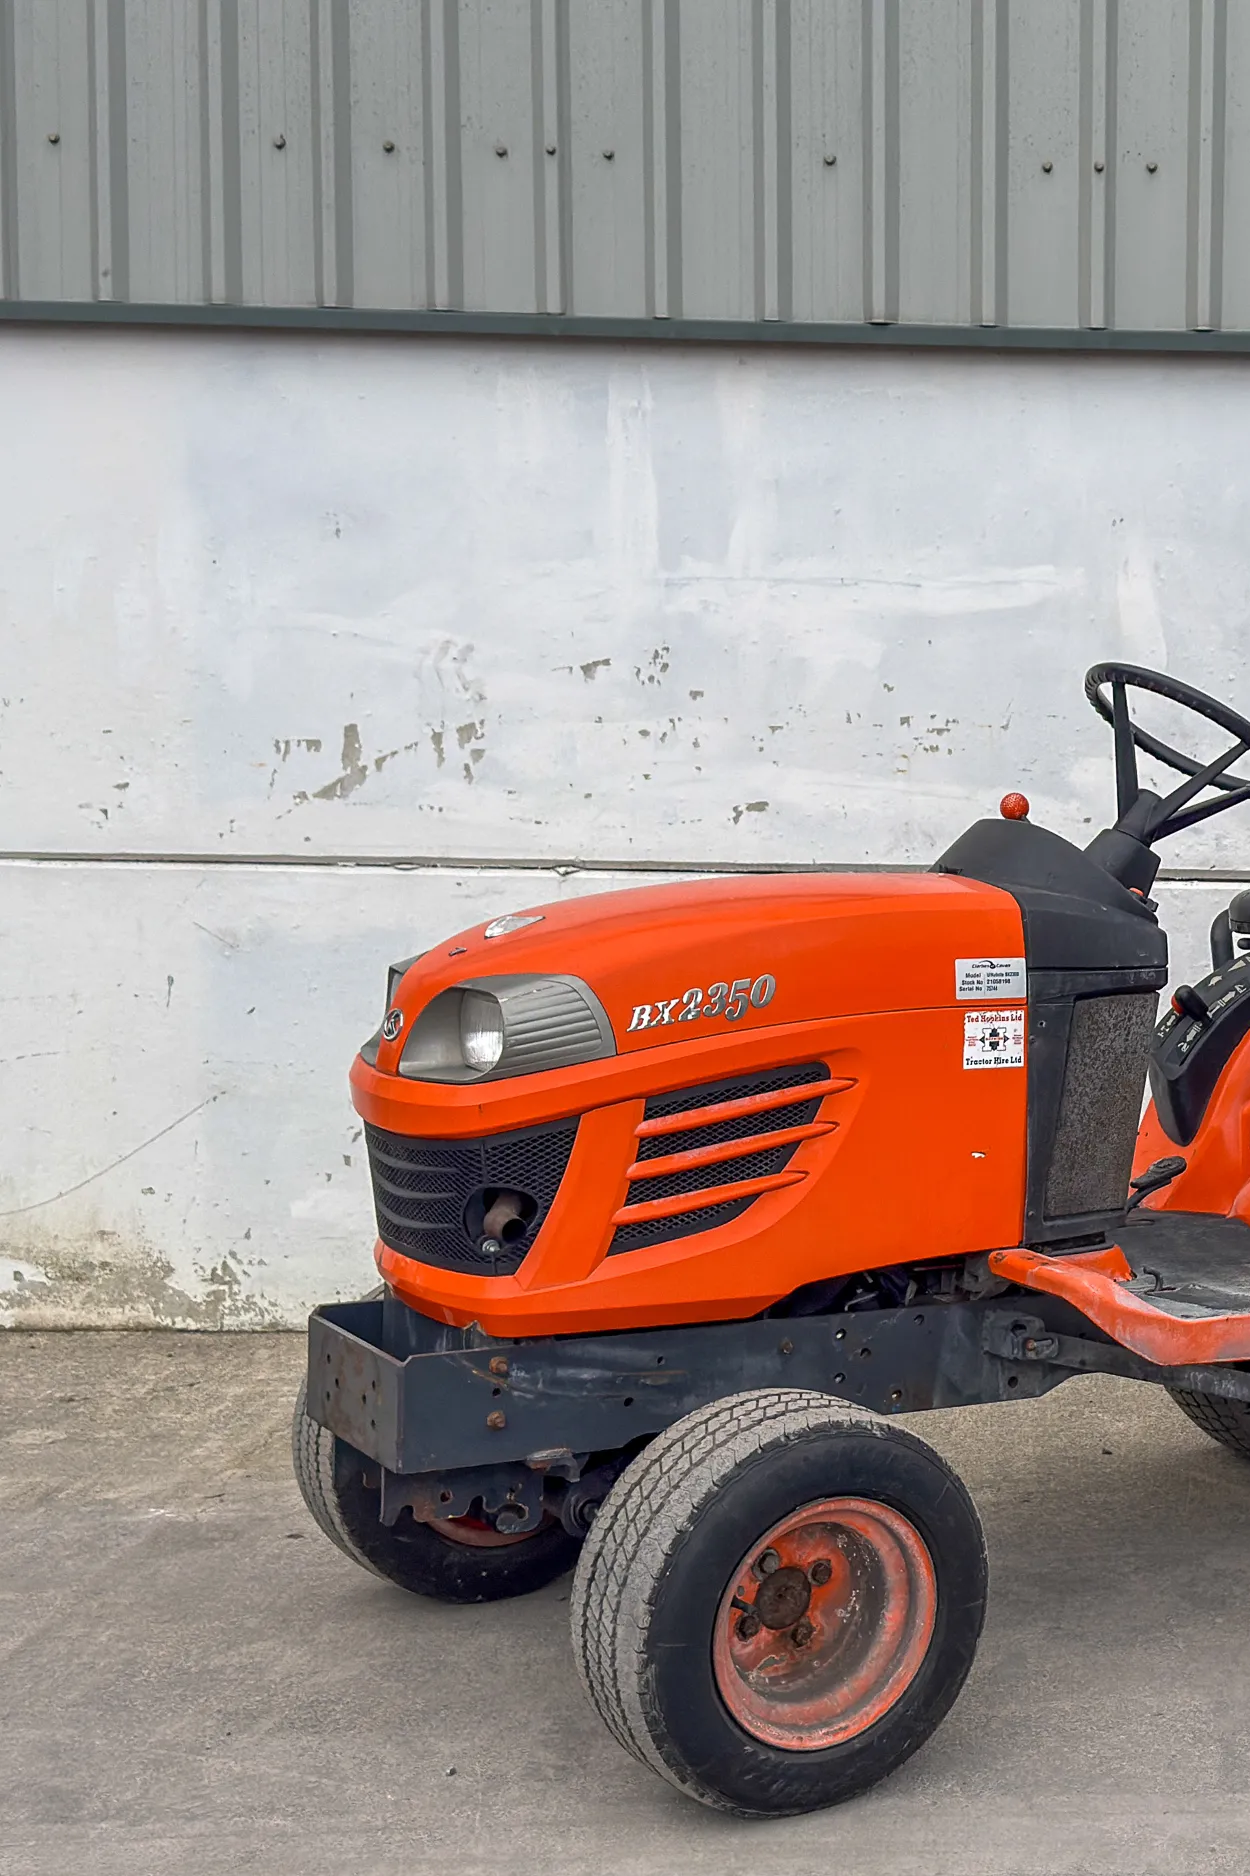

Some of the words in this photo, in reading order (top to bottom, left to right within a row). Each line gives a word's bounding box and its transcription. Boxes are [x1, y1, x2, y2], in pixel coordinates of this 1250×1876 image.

[626, 973, 776, 1032] BX2350
[966, 1015, 979, 1023] Ted
[981, 1014, 1009, 1023] Hopkins
[1010, 1013, 1022, 1022] Ltd
[965, 1057, 992, 1066] Tractor
[993, 1056, 1009, 1065] Hire
[1010, 1055, 1022, 1064] Ltd
